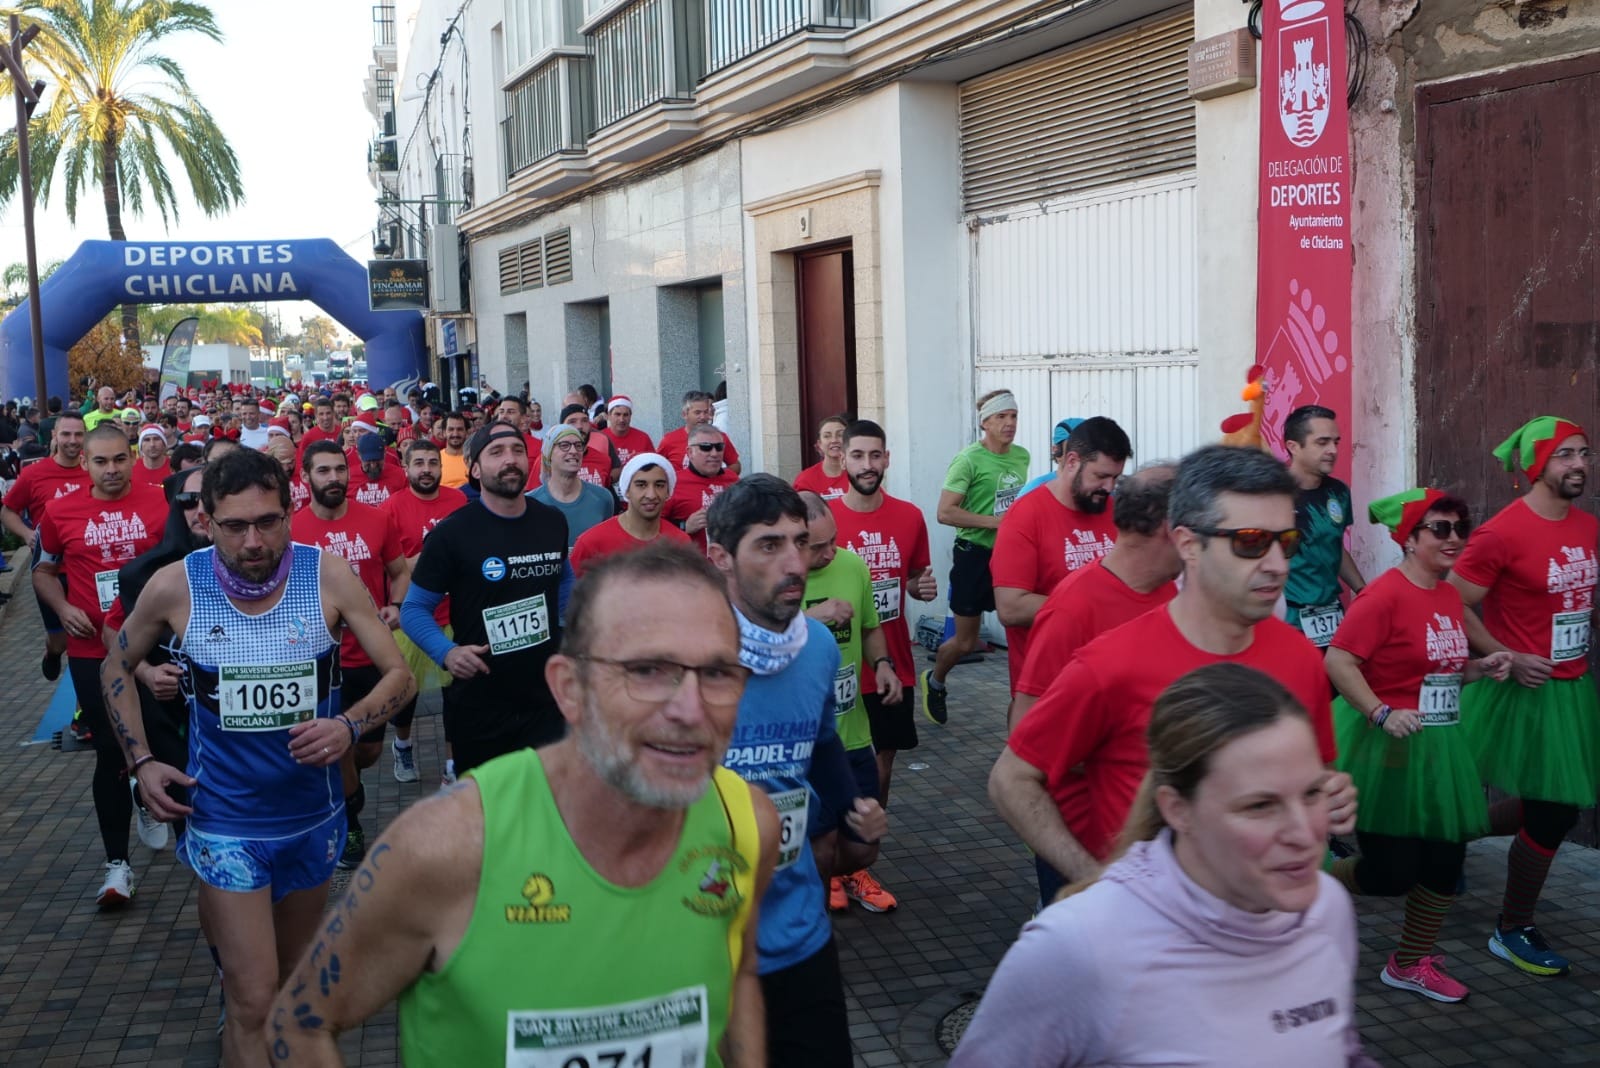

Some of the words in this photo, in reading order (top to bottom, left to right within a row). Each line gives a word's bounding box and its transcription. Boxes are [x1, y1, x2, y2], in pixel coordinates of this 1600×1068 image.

[1268, 155, 1328, 178] DELEGACIÓN
[1330, 156, 1343, 174] DE
[1270, 182, 1341, 207] DEPORTES
[1289, 213, 1344, 230] Ayuntamiento
[1300, 236, 1310, 249] de
[1311, 235, 1344, 249] Chiclana
[124, 244, 293, 266] DEPORTES
[124, 272, 297, 296] CHICLANA
[862, 531, 882, 546] SAN
[507, 553, 543, 565] SPANISH
[497, 611, 540, 638] 1175
[240, 666, 270, 674] SILVESTRE
[272, 663, 313, 673] CHICLANERA
[236, 681, 301, 710] 1063
[224, 715, 275, 727] CHICLANA
